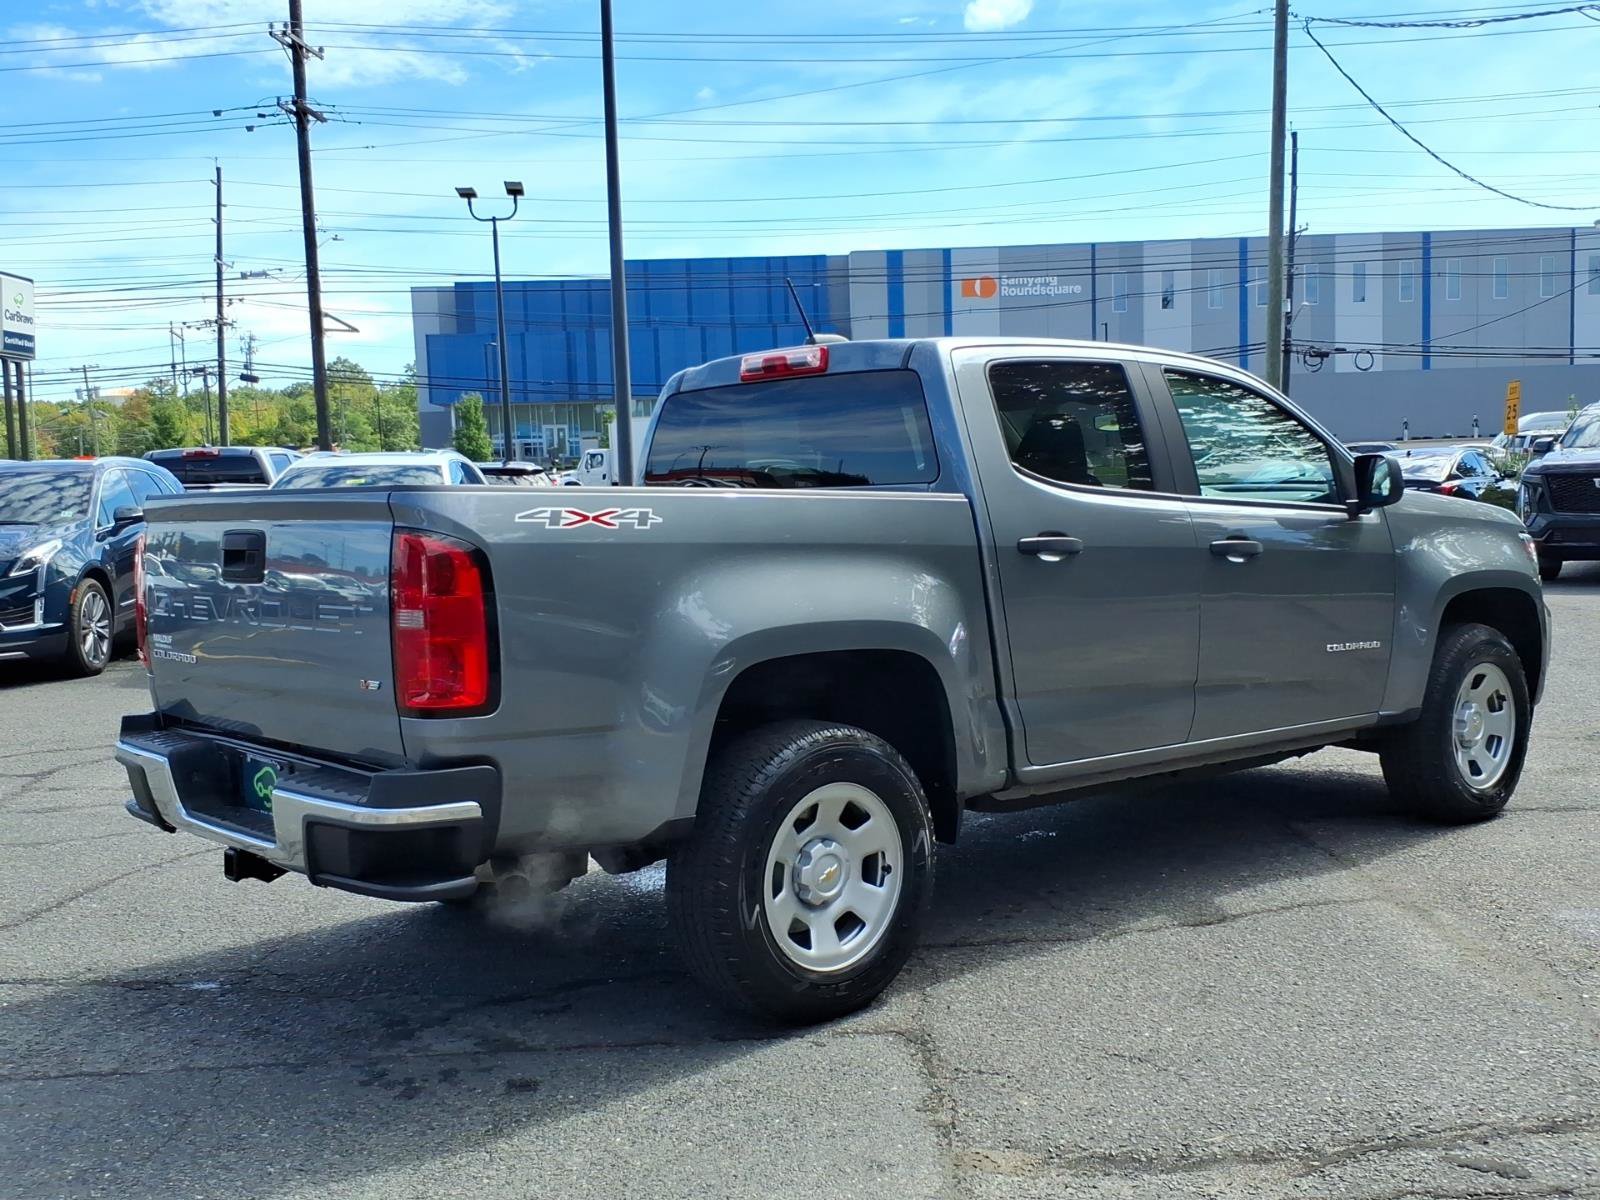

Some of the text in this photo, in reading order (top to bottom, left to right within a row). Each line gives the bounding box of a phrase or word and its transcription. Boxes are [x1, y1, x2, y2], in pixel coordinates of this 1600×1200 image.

[1001, 275, 1058, 286] Samyang
[1001, 284, 1082, 297] Roundsquare
[4, 308, 34, 325] CarBravo
[1506, 404, 1517, 420] 25
[1326, 641, 1381, 652] COLORADO
[152, 648, 197, 664] COLORADO
[360, 679, 380, 690] V6
